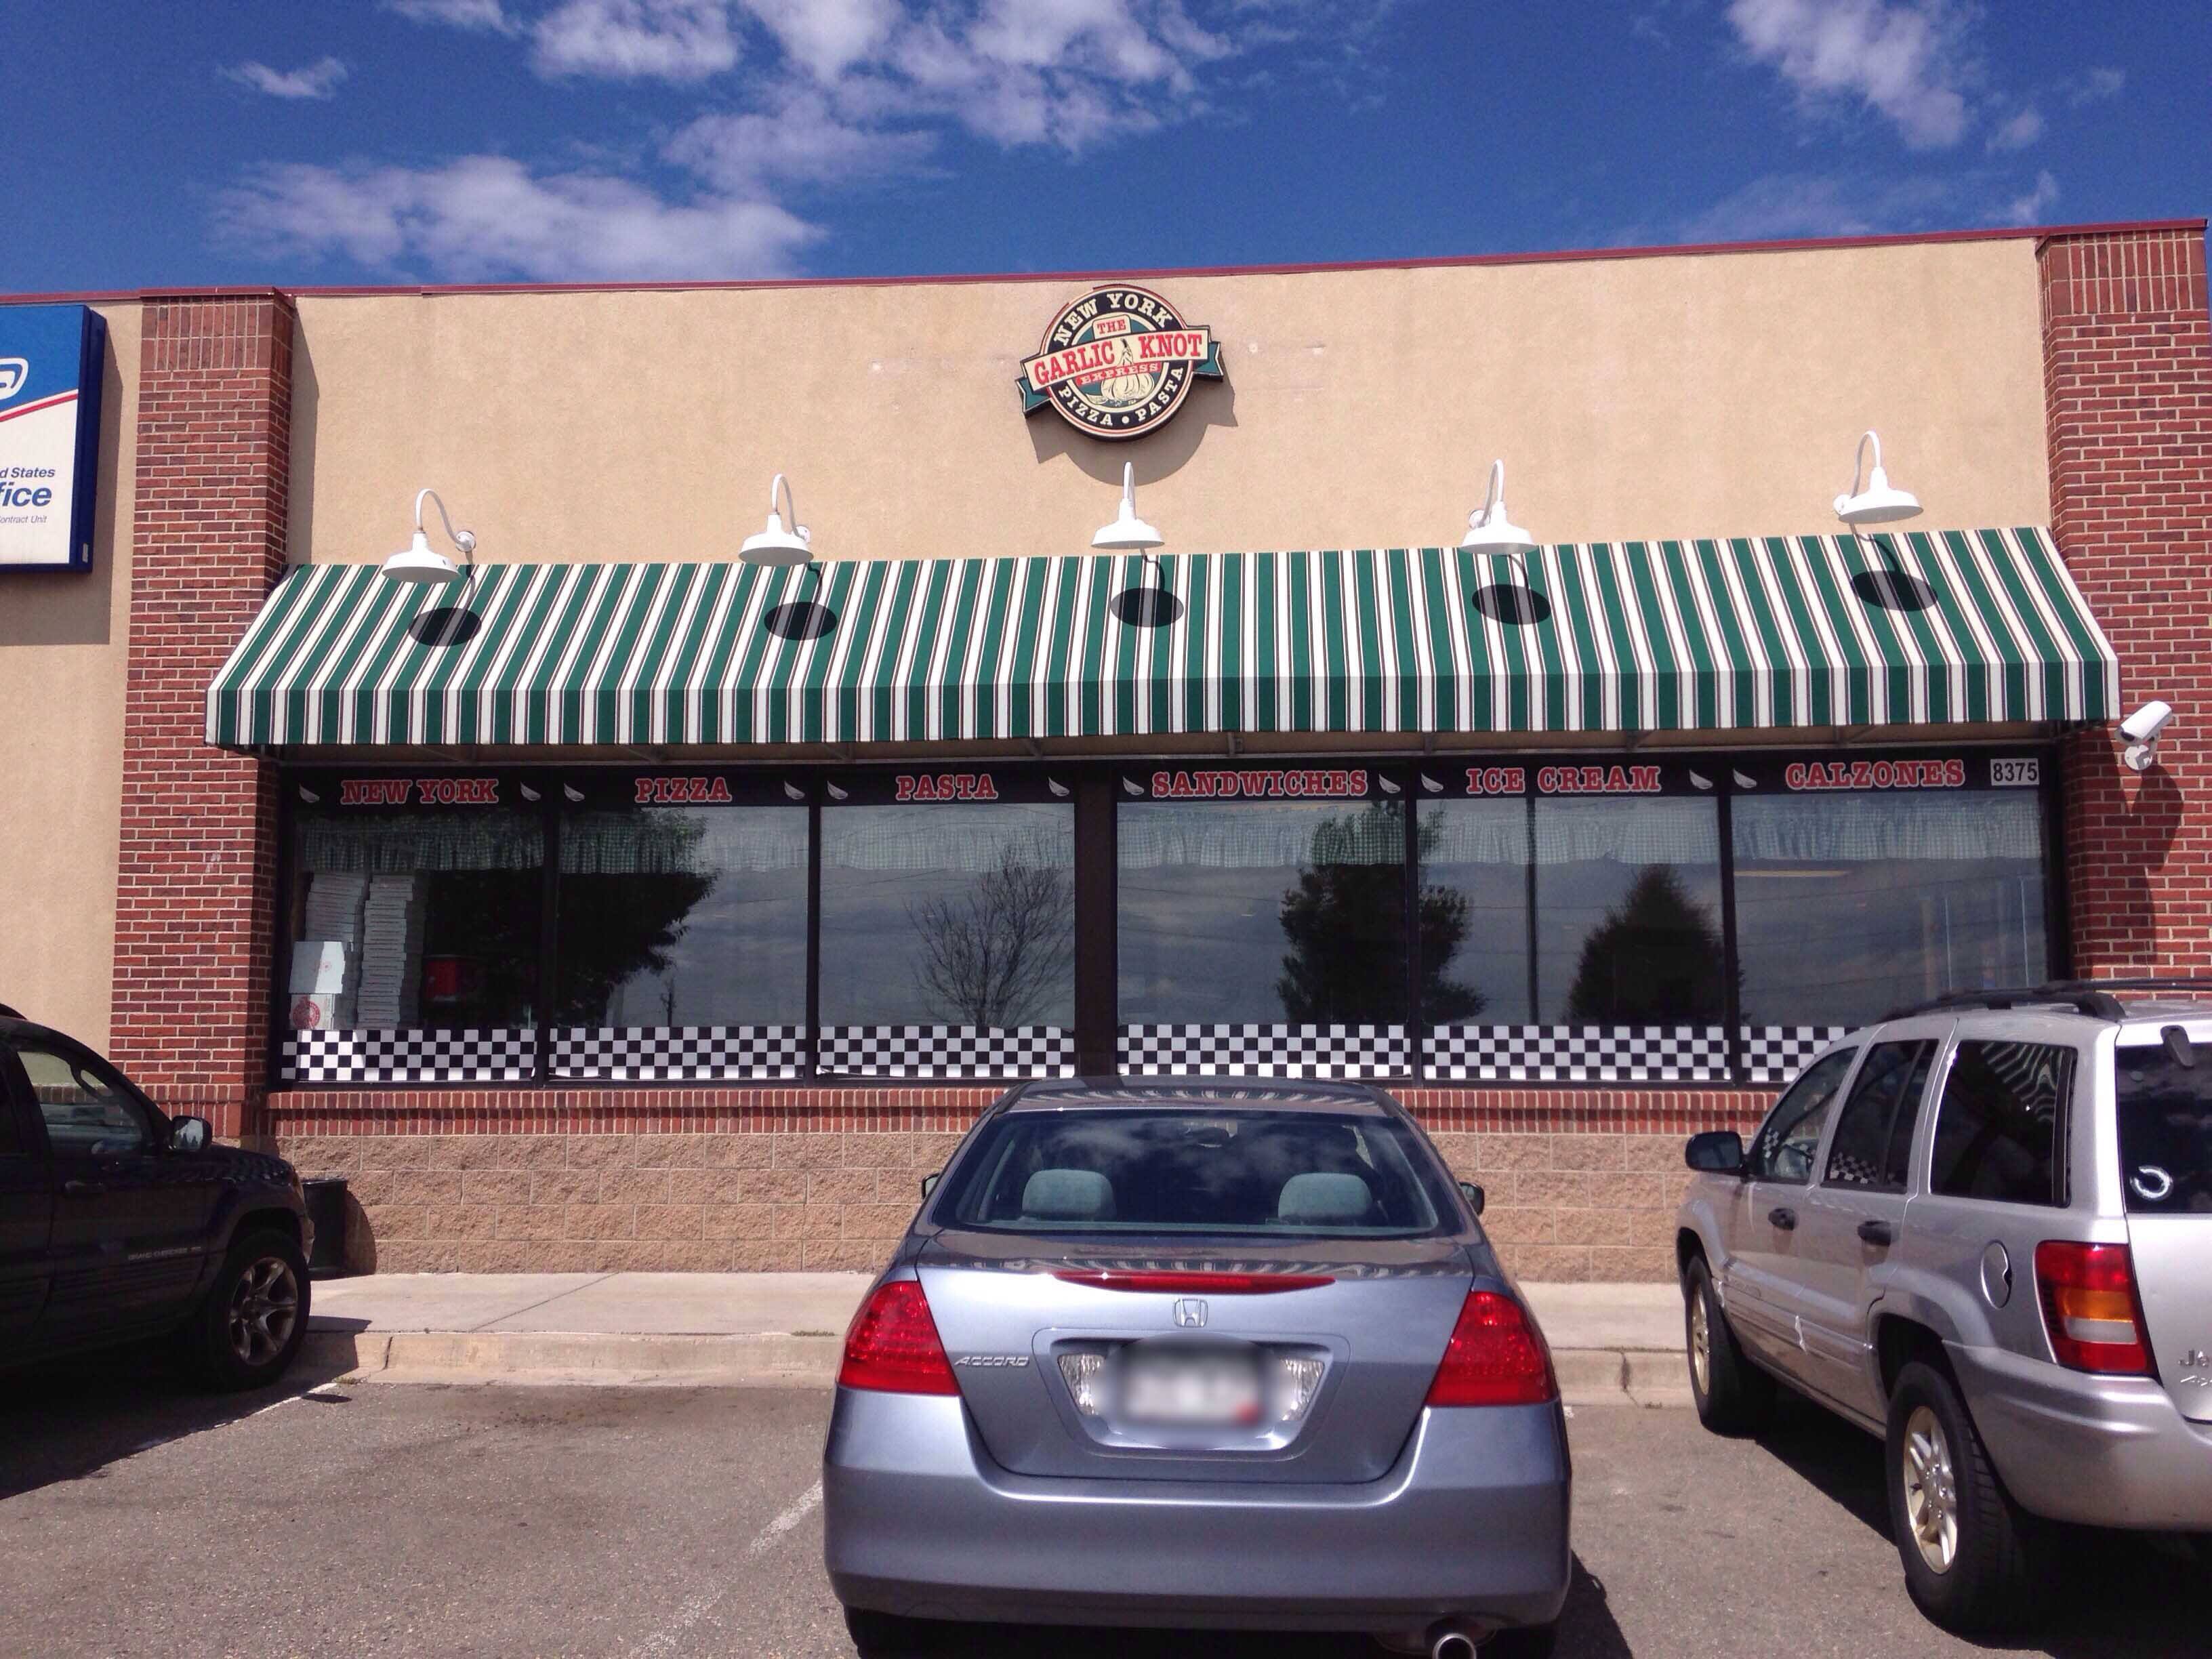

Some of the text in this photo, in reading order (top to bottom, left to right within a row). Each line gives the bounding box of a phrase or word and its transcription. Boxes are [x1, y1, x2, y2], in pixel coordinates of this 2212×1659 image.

[1053, 293, 1173, 346] NEW YORK
[1097, 319, 1127, 335] THE
[1033, 333, 1203, 386] GARLIC KNOT
[1081, 363, 1159, 385] EXPRESS
[1058, 367, 1184, 426] PIZZA PASTA
[11, 467, 56, 478] States
[0, 515, 47, 524] ontract Unit
[1151, 770, 1368, 797] SANDWICHES
[1466, 766, 1661, 794] ICE CREAM
[1785, 758, 1967, 790] CALZONES
[1992, 762, 2037, 781] 8375
[340, 779, 499, 804] NEW YORK
[634, 777, 733, 803] PIZZA
[895, 773, 999, 801] PASTA
[954, 1355, 1029, 1366] ACCORD
